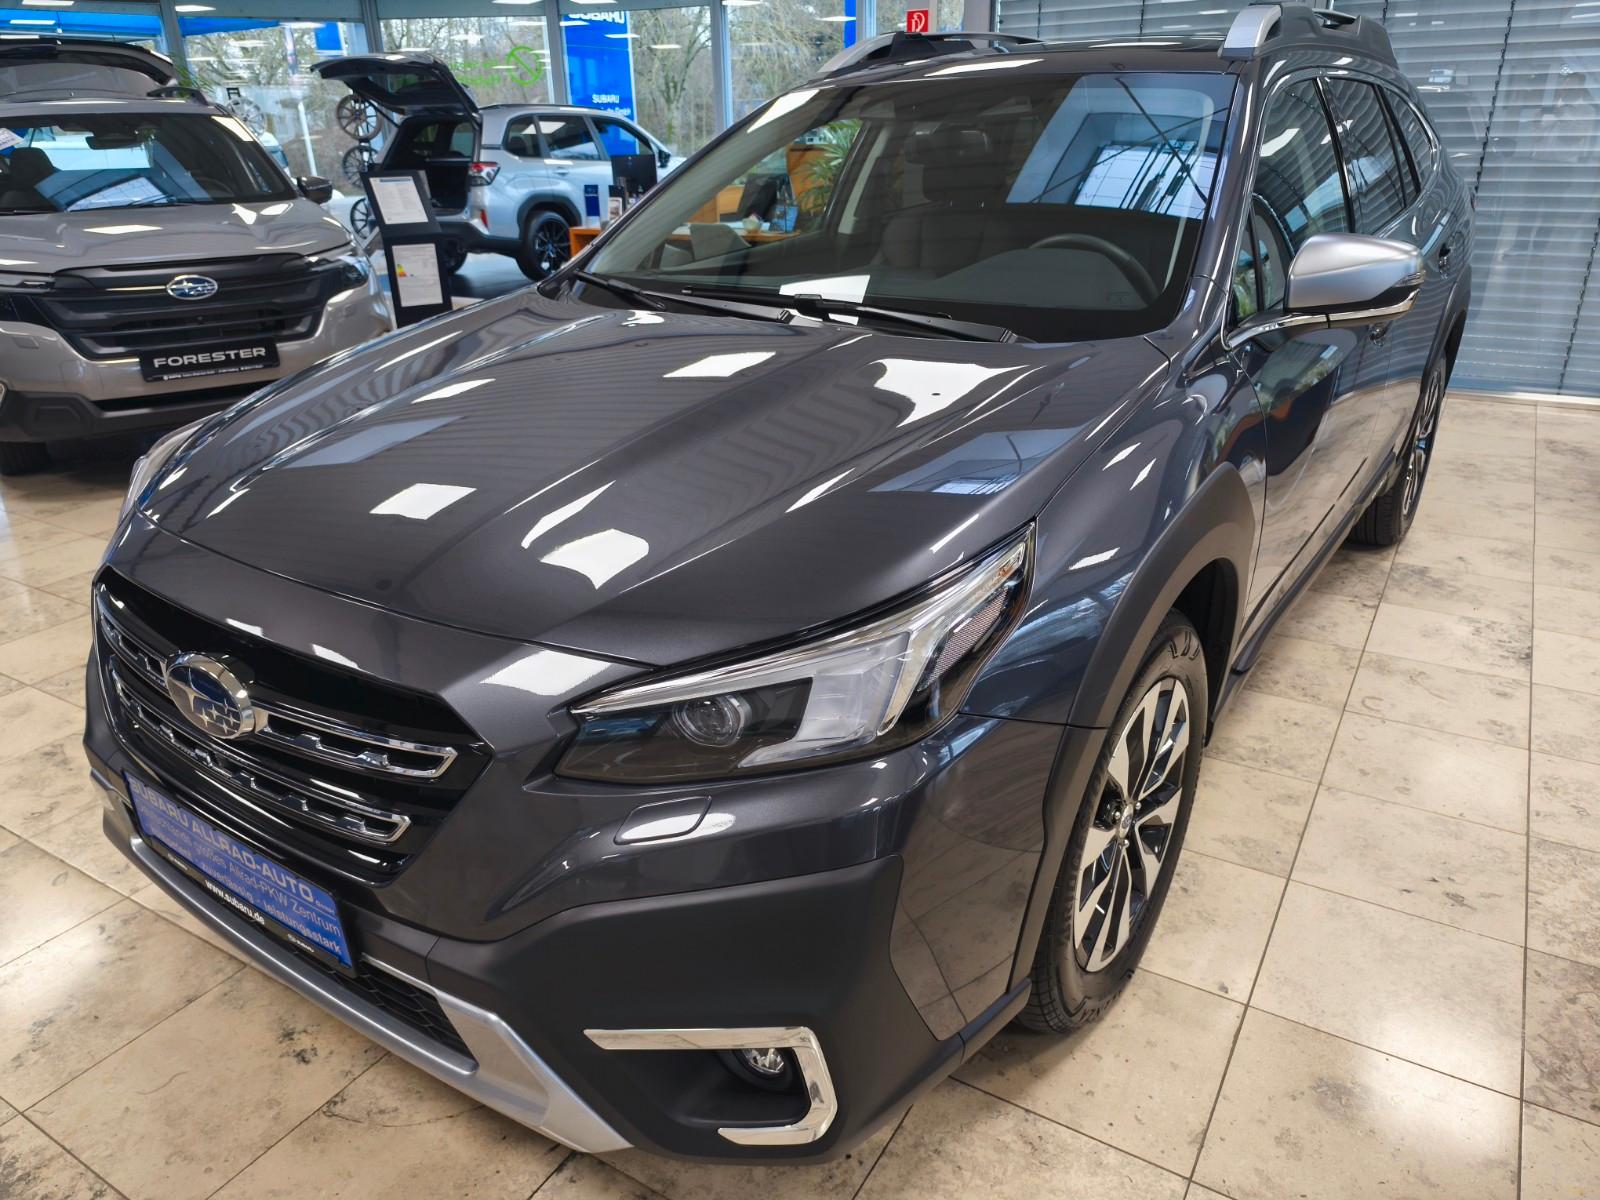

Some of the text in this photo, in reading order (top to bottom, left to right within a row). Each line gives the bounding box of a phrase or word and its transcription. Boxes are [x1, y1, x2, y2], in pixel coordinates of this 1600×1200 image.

[592, 94, 620, 104] SUBARU
[153, 347, 266, 368] FORESTER
[130, 780, 189, 828] SUBARU
[192, 819, 314, 903] ALLRAD-AUTO
[204, 879, 265, 925] www.subaru.de
[290, 898, 341, 937] Zentrum
